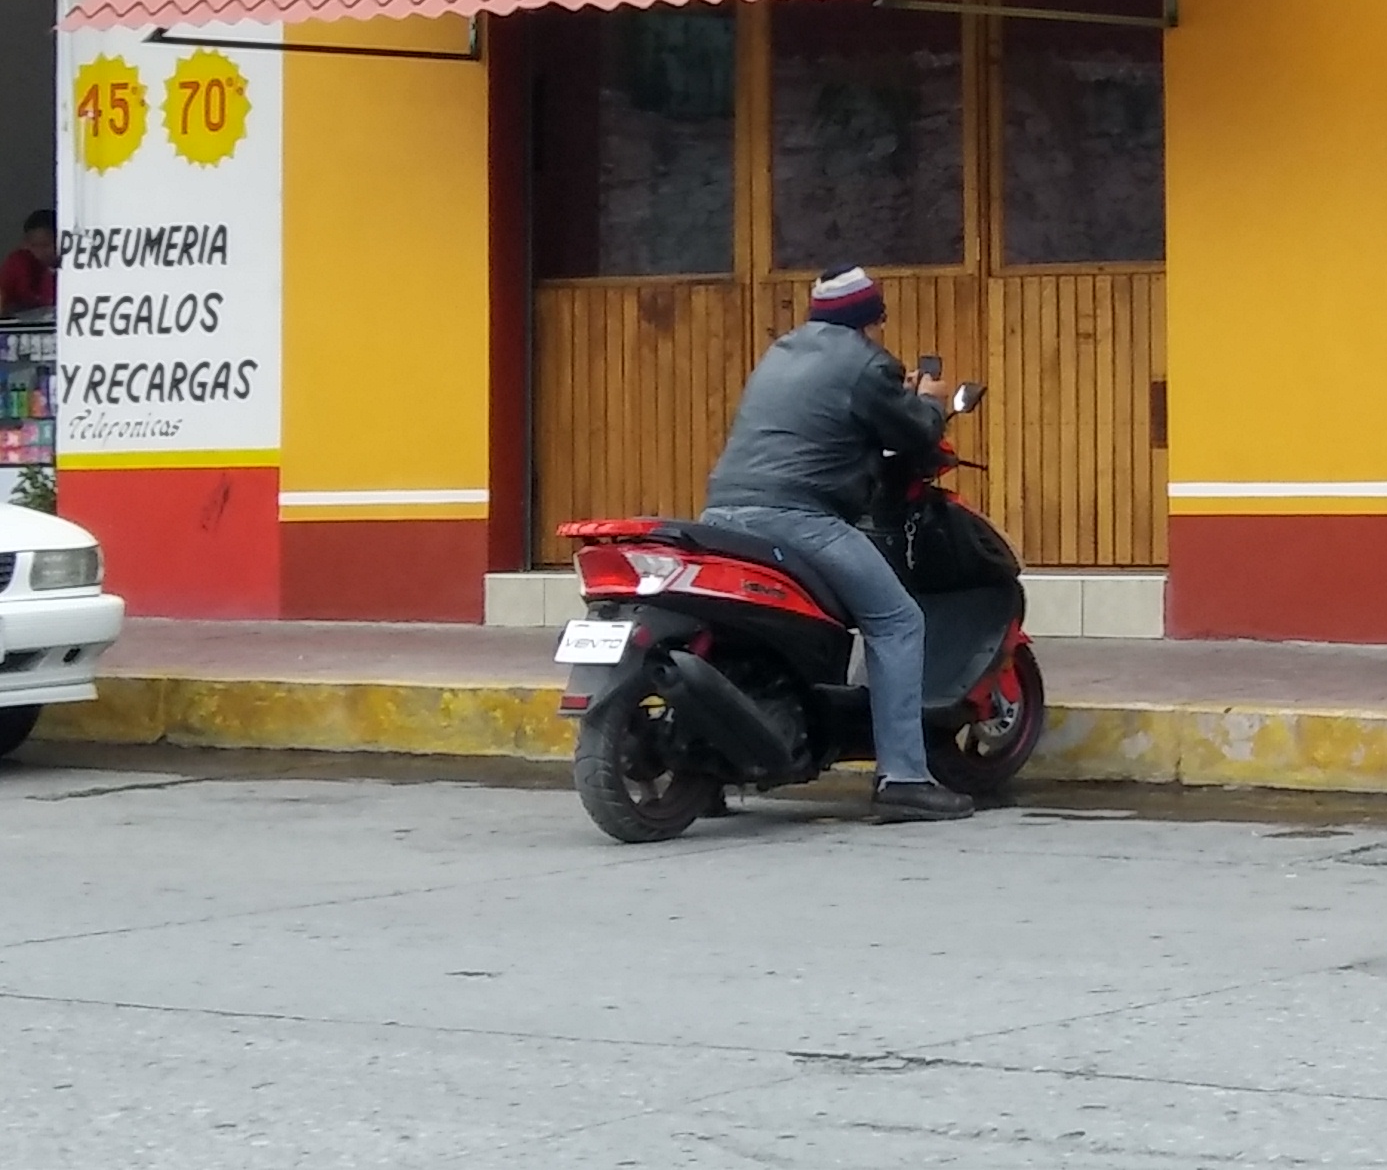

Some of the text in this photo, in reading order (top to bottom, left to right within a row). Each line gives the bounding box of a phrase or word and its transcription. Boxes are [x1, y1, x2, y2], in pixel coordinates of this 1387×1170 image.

[58, 225, 228, 269] PERFUMERIA
[66, 292, 224, 337] REGALOS
[60, 359, 258, 404] Y RECARGAS
